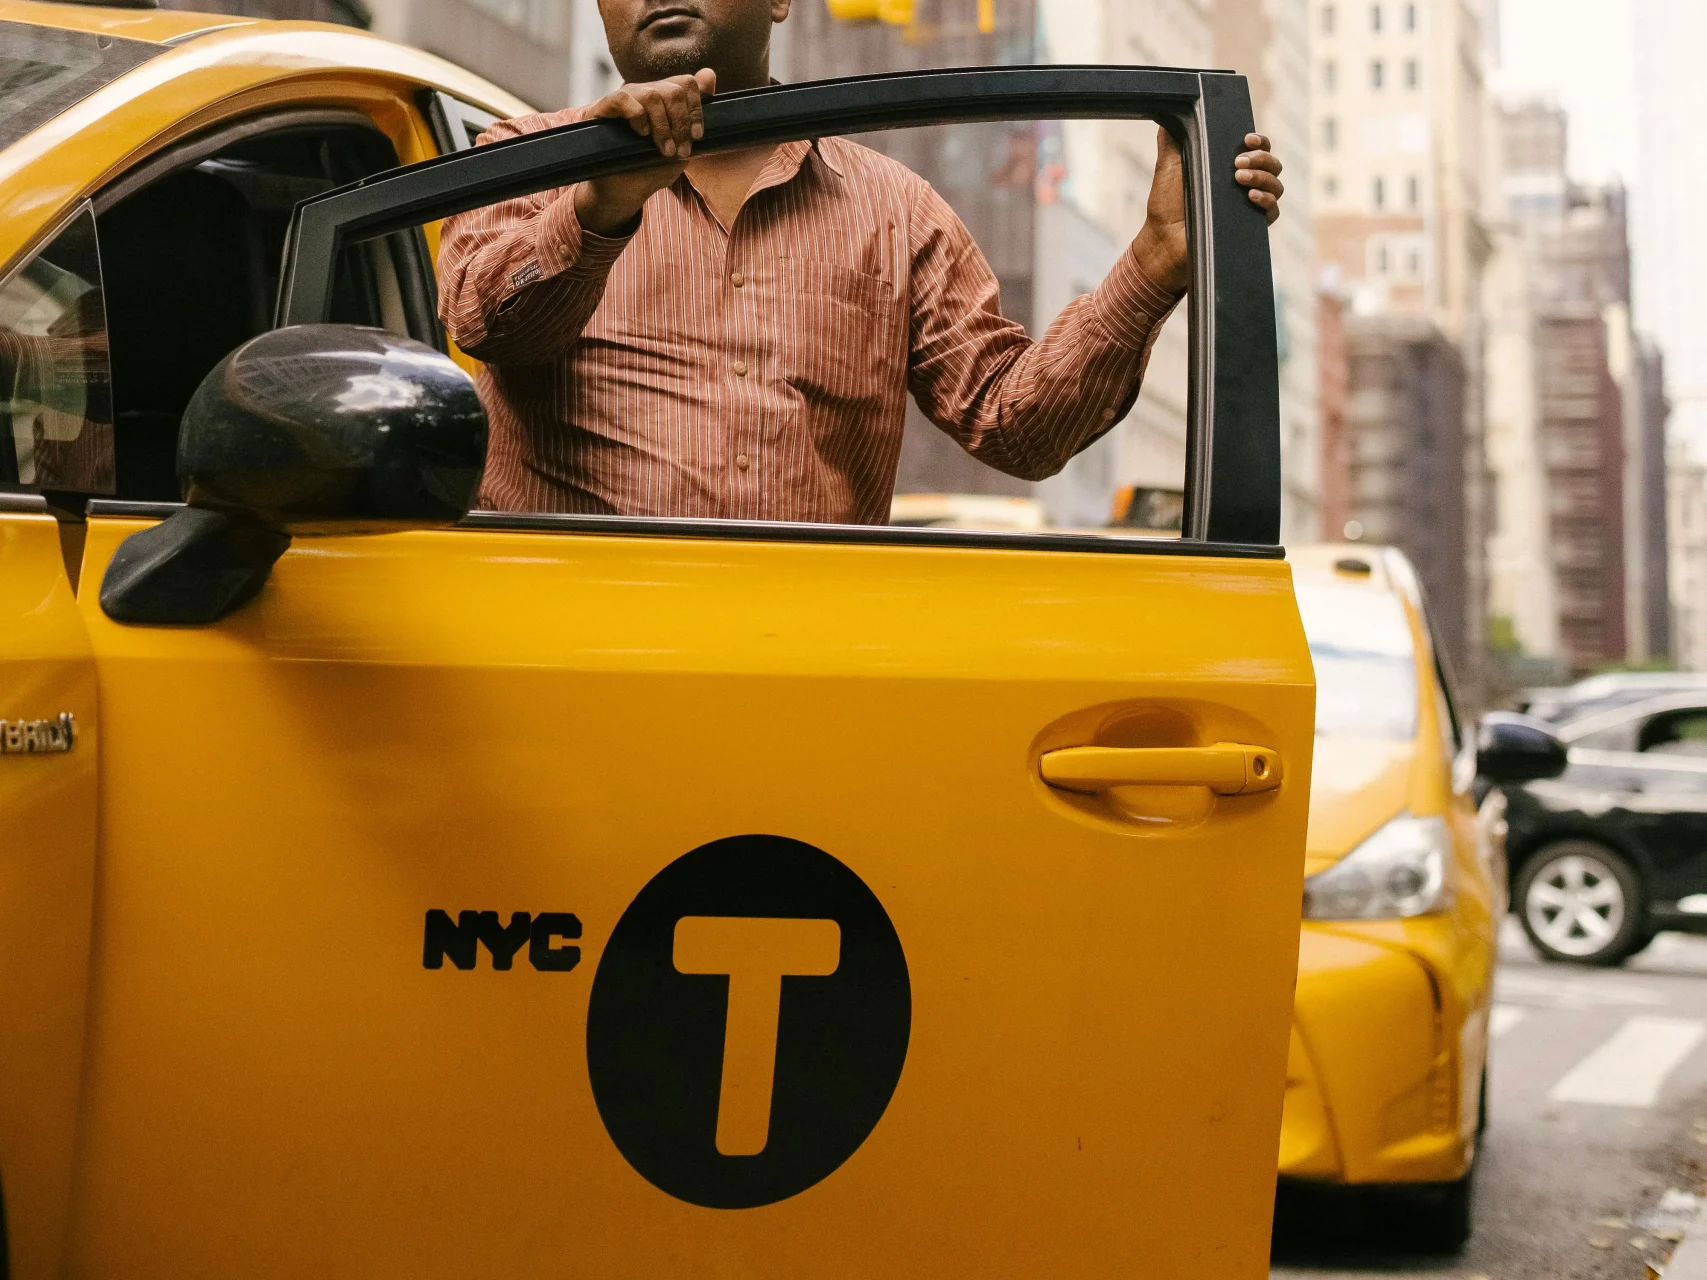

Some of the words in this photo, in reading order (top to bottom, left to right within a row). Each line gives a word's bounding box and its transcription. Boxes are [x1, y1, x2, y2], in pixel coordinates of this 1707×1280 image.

[0, 718, 72, 753] BRID
[422, 909, 583, 972] NYC
[672, 915, 842, 1156] T
